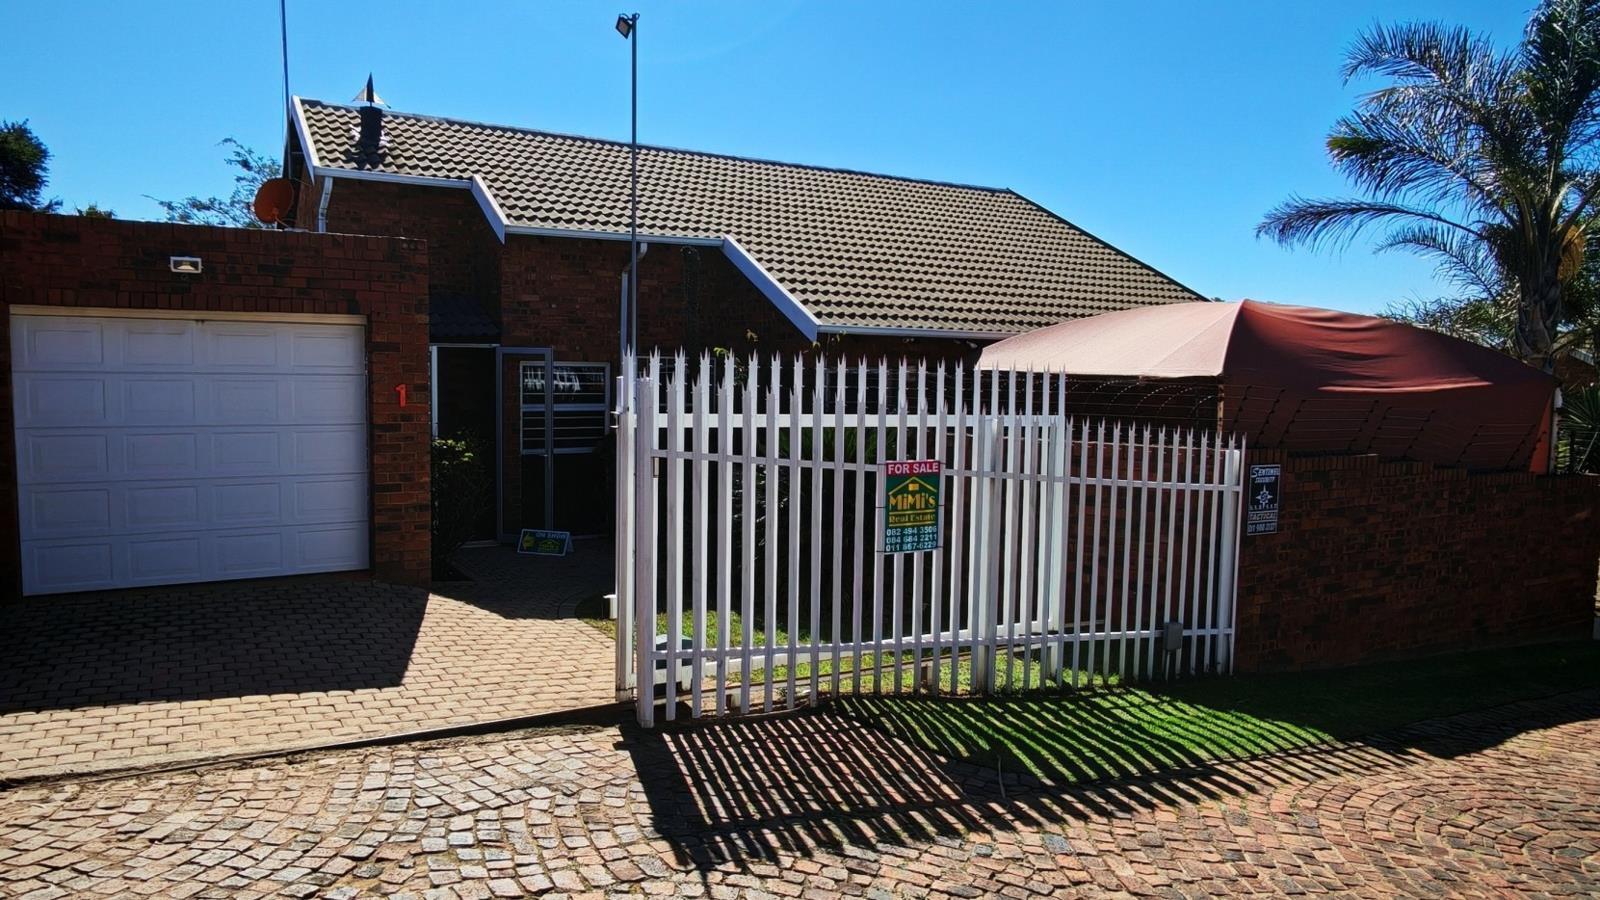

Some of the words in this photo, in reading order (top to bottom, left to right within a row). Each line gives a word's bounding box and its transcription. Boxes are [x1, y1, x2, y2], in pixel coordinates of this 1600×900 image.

[395, 383, 406, 408] 1
[888, 463, 910, 475] FOR
[912, 462, 939, 473] SALE
[889, 514, 909, 523] Real
[910, 513, 936, 522] Estate
